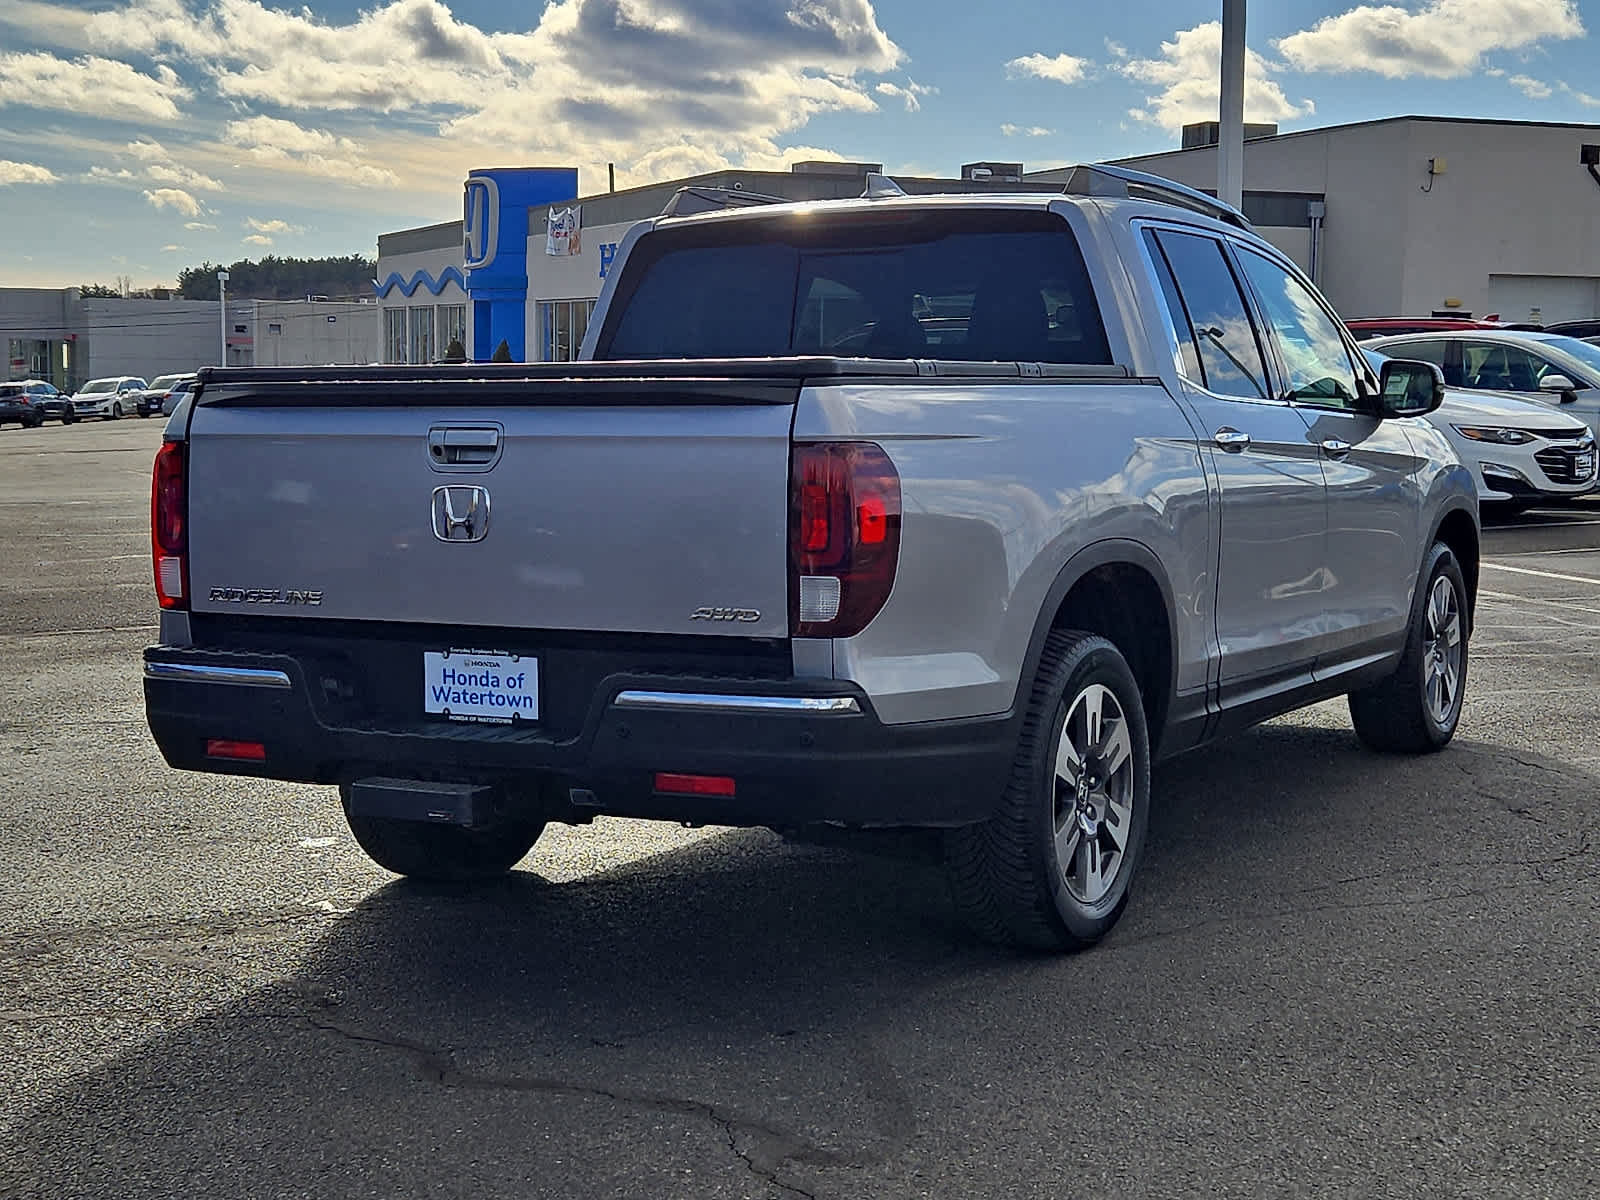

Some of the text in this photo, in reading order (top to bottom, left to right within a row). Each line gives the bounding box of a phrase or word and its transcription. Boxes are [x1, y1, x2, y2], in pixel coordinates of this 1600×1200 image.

[209, 586, 322, 605] RIDGELINE
[690, 607, 761, 622] AWD
[471, 660, 501, 668] HONDA
[442, 668, 525, 689] Honda of
[432, 685, 533, 709] Watertown
